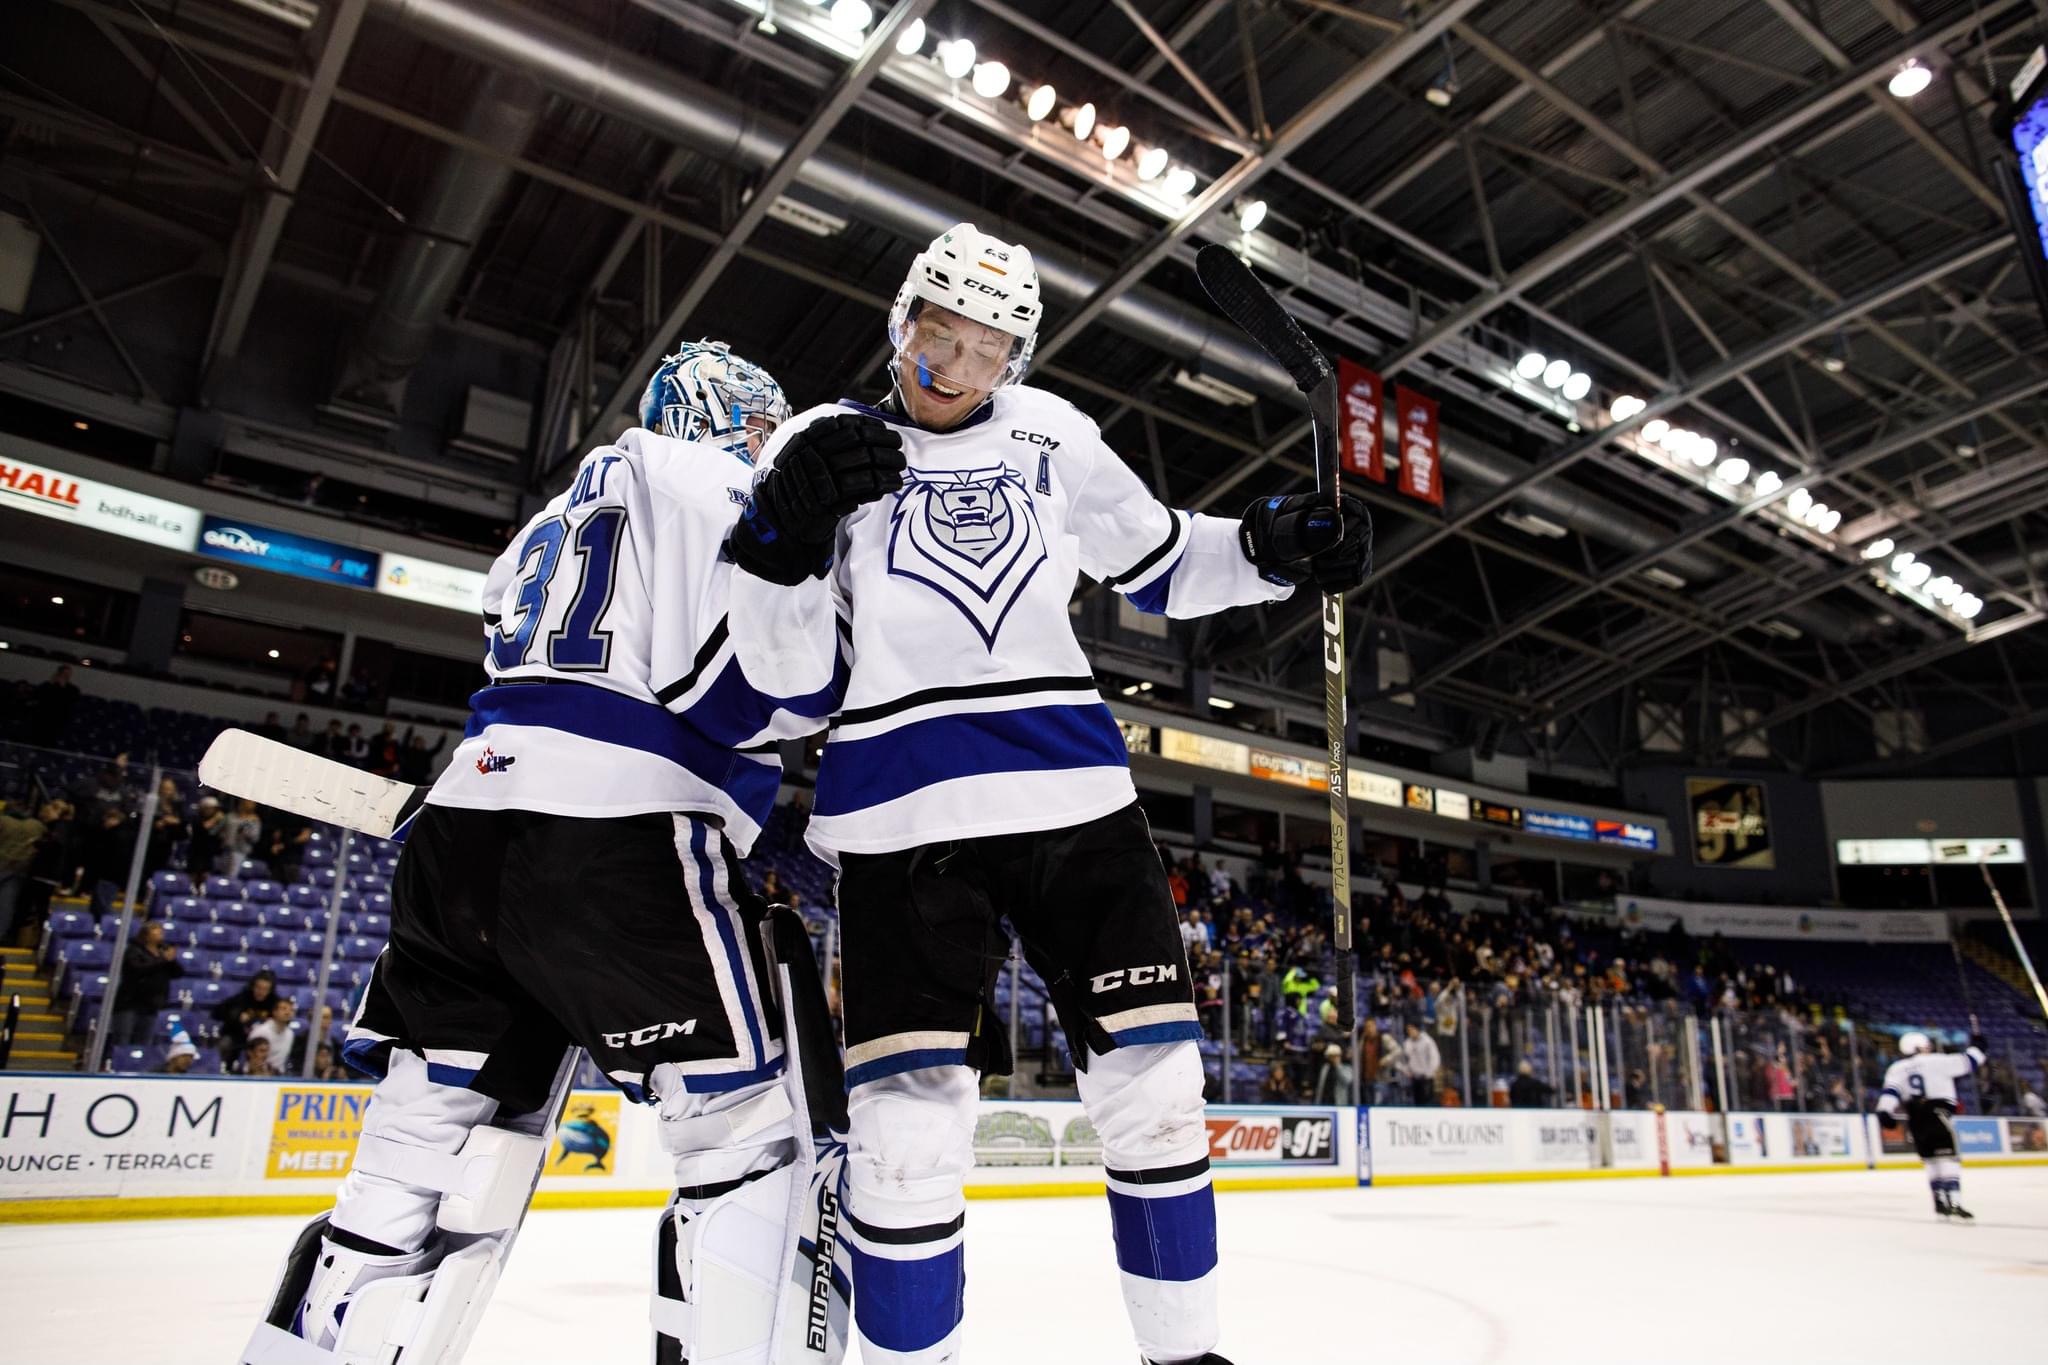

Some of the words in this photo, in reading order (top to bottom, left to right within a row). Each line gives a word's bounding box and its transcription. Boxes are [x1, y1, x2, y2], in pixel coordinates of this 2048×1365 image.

[963, 277, 1011, 301] CCM
[1010, 429, 1061, 451] CCM
[1035, 451, 1052, 497] A
[98, 501, 183, 535] bdhall.ca
[1307, 520, 1333, 528] CCM
[203, 528, 270, 557] GALAXY
[491, 504, 628, 674] 31
[1322, 592, 1342, 675] CC
[486, 755, 508, 772] CHL
[1332, 823, 1344, 891] TACKS
[1089, 963, 1178, 994] CCM
[601, 1018, 698, 1049] CCM
[1909, 1073, 1926, 1098] 9
[1387, 1120, 1433, 1147] TIMES
[1437, 1119, 1505, 1146] COLONIST
[0, 1153, 81, 1172] UNGE
[103, 1153, 214, 1171] TERRACE
[279, 1151, 350, 1171] MEET
